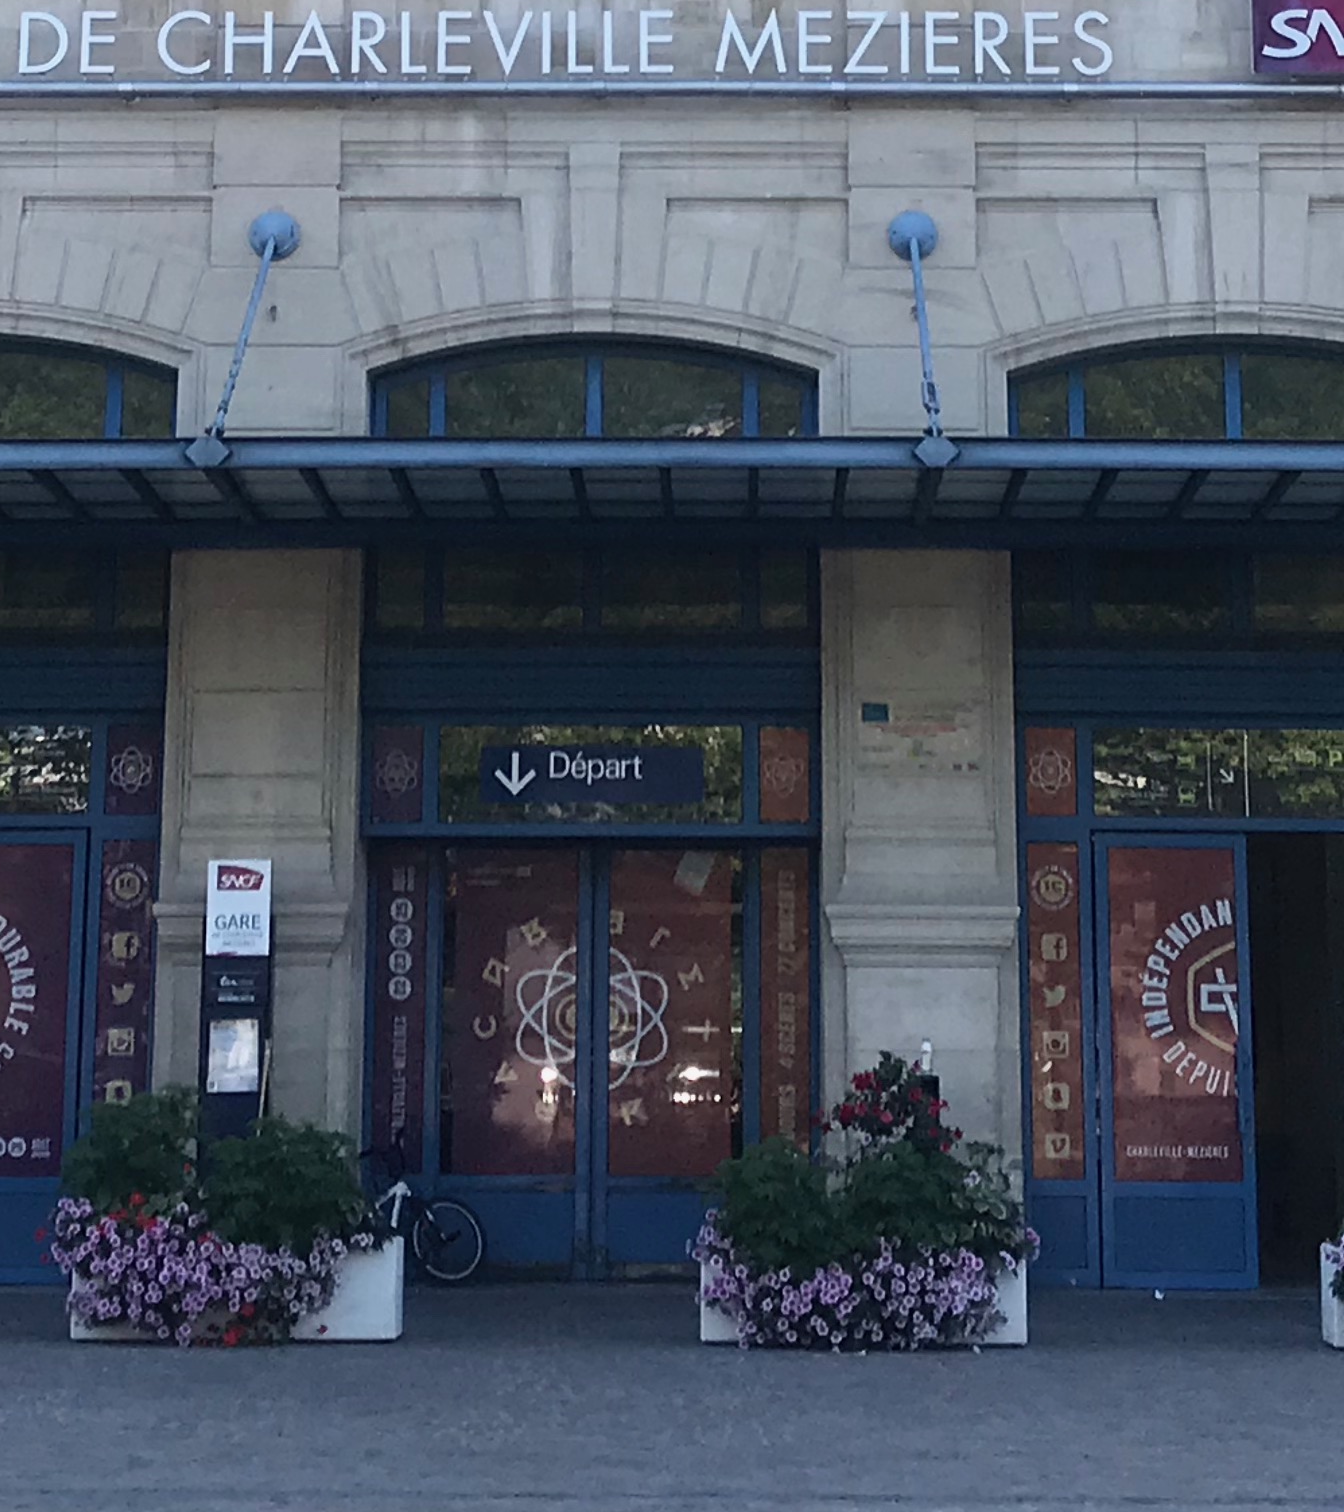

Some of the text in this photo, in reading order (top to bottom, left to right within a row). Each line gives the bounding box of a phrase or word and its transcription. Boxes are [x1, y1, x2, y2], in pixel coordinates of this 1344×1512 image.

[18, 10, 117, 75] DE
[157, 8, 674, 76] CHARLEVILLE
[715, 8, 1115, 77] MEZIERES
[549, 751, 643, 786] Départ
[219, 873, 261, 889] SNCF
[214, 914, 261, 930] GARE
